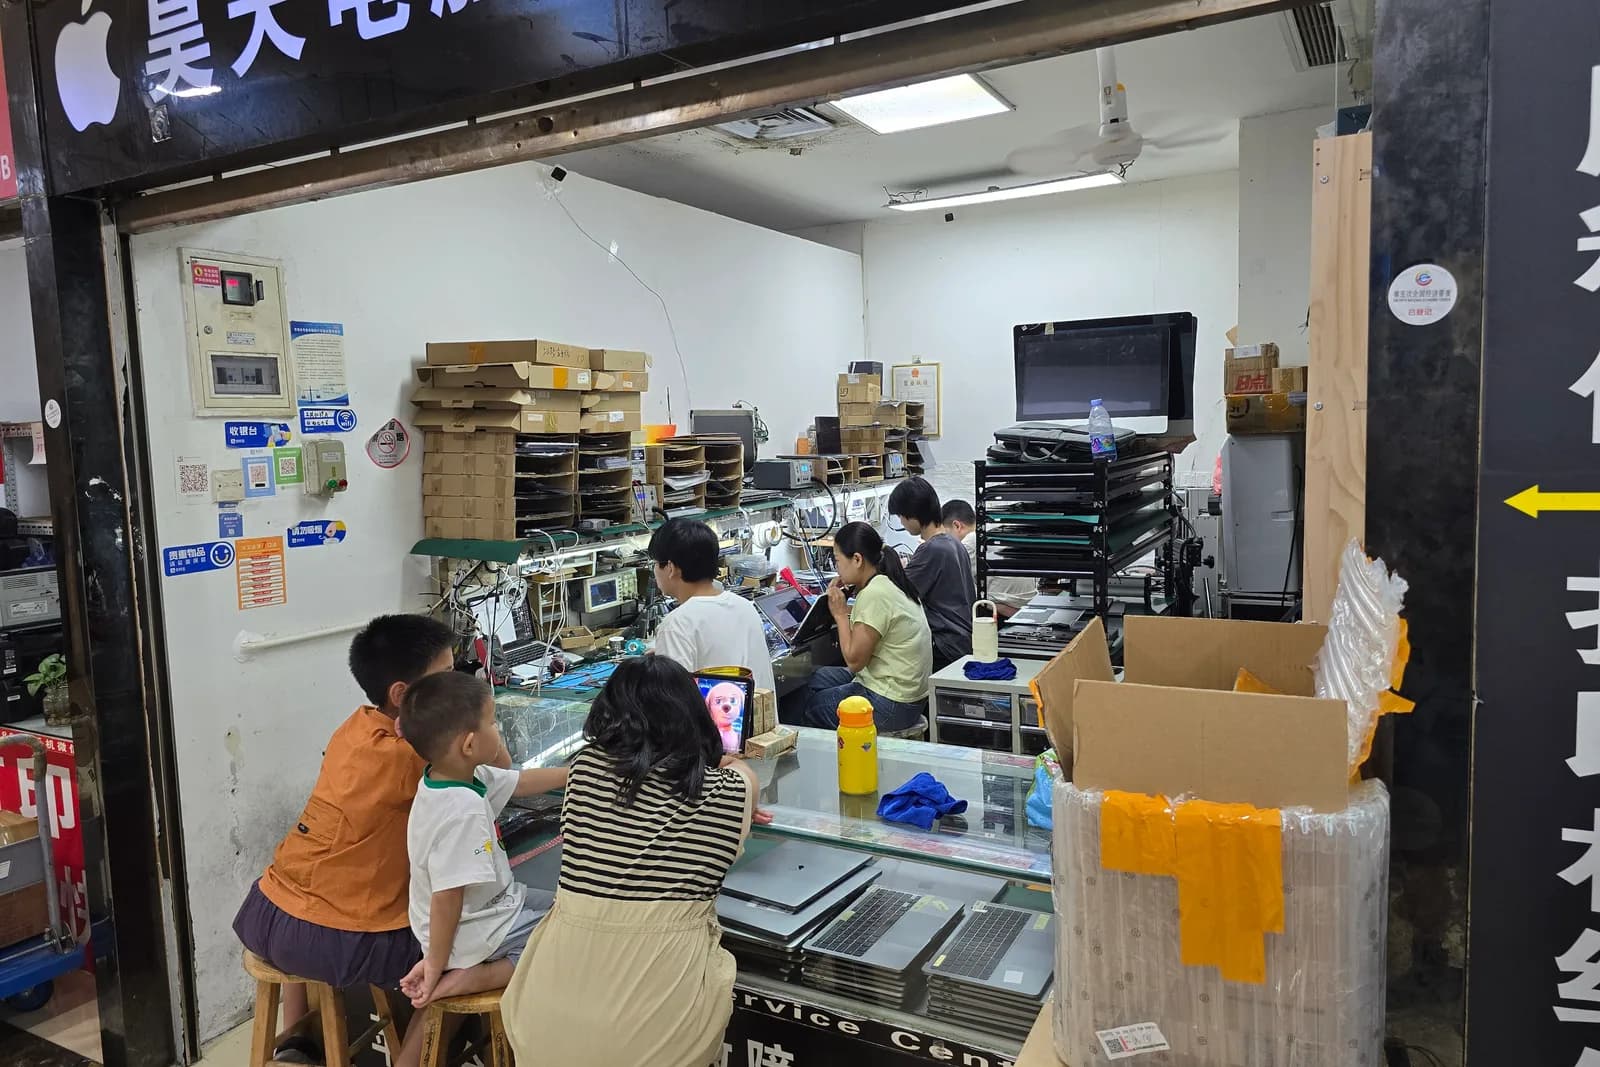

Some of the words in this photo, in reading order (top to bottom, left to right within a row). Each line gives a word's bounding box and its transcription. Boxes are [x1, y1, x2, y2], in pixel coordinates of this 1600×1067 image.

[229, 425, 258, 436] 收银台
[168, 546, 206, 560] 贵重物品
